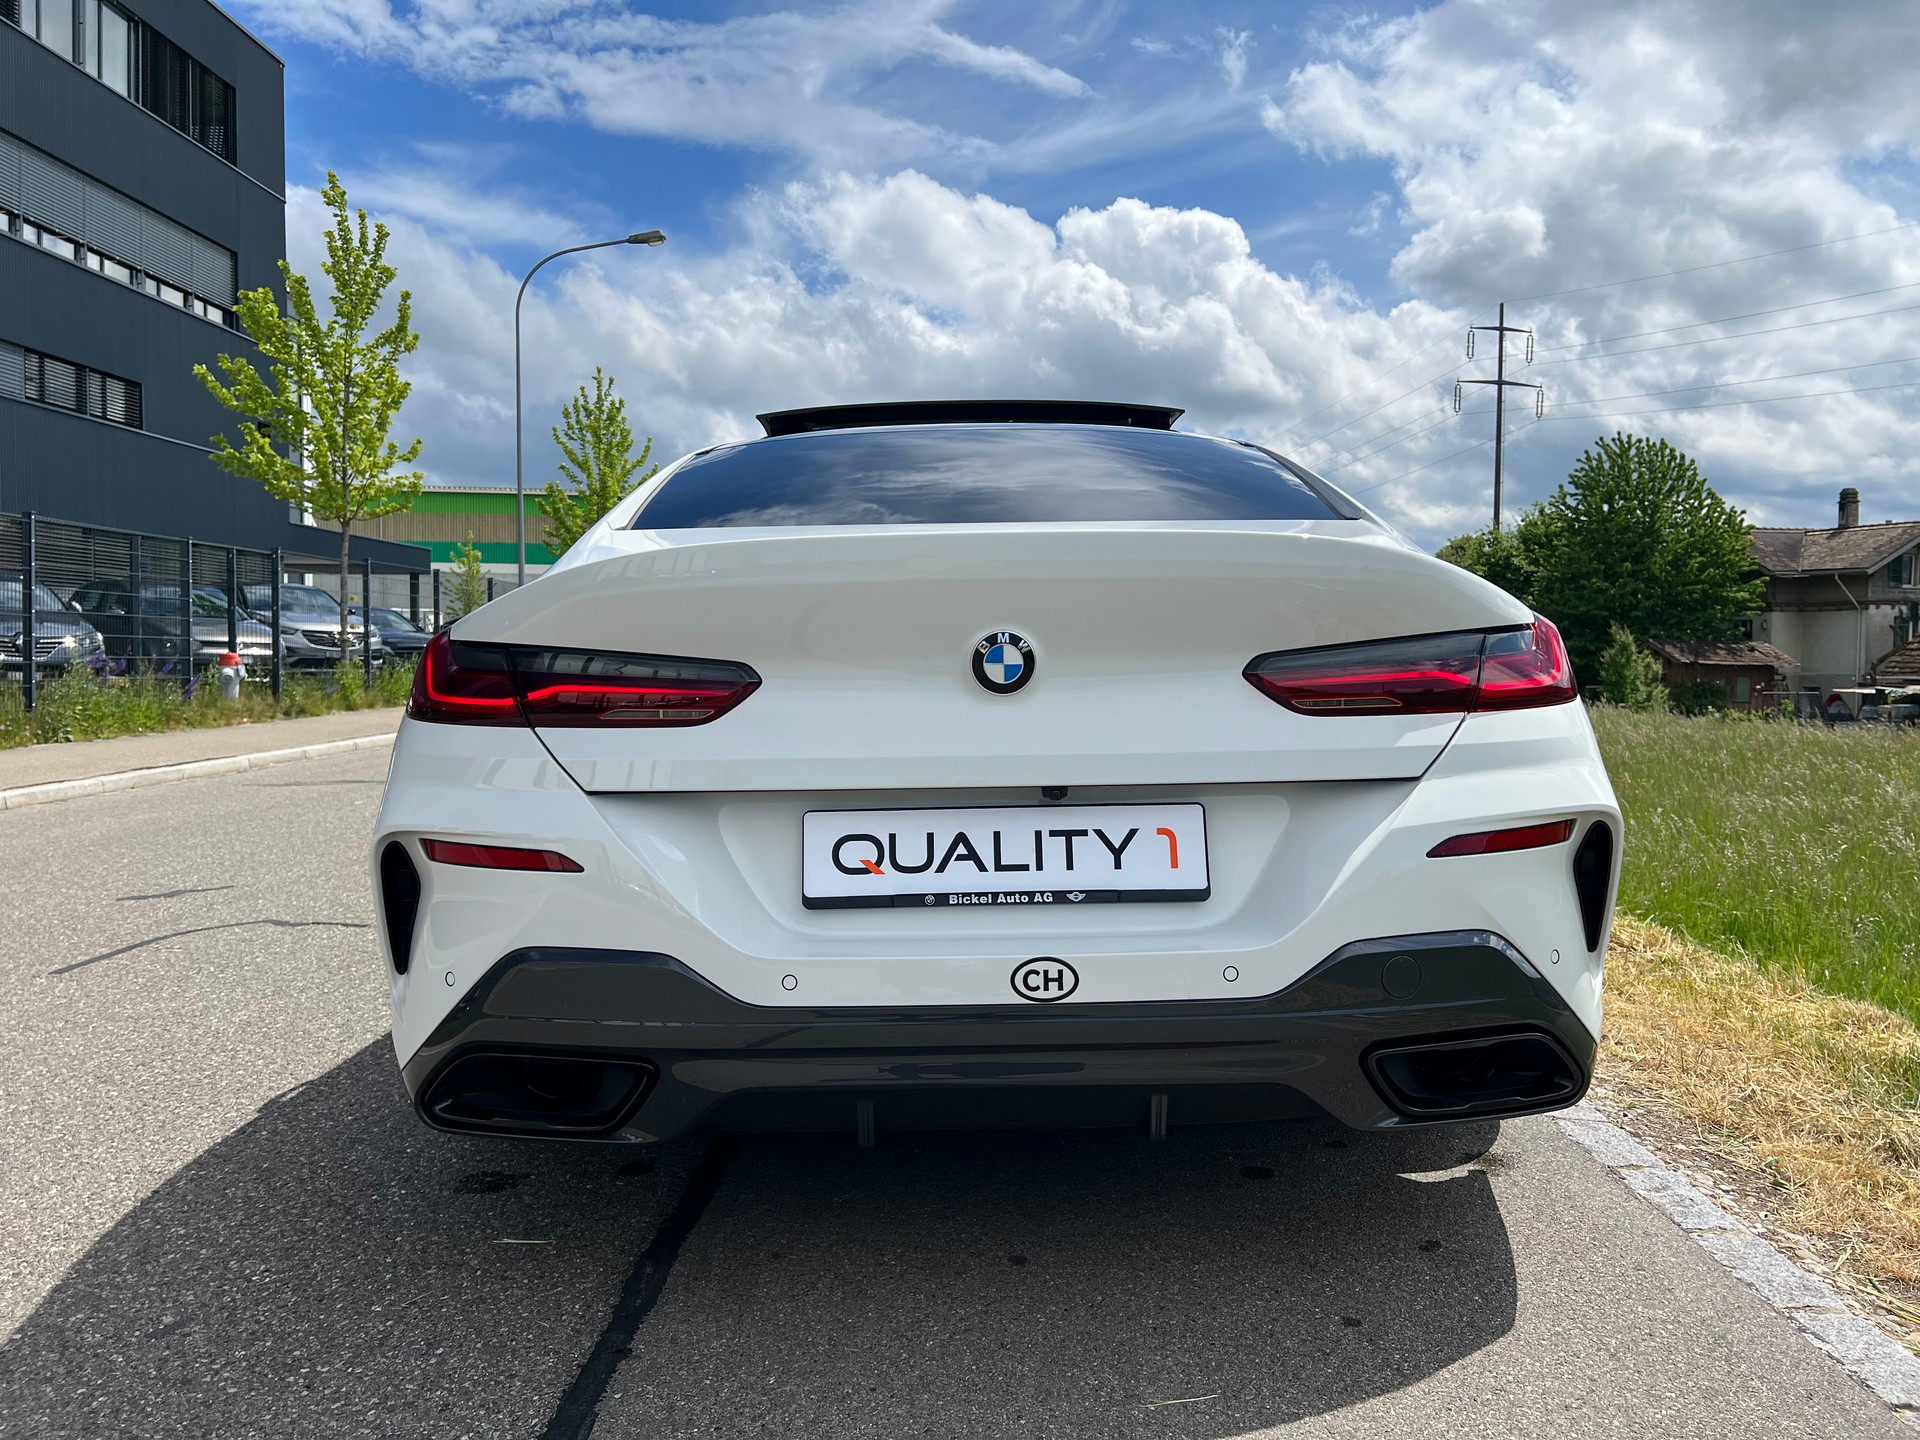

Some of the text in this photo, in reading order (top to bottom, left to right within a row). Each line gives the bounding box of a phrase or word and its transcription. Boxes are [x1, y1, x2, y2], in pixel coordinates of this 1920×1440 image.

[977, 633, 1030, 654] BMW
[831, 828, 1140, 875] QUALITY
[949, 892, 1053, 904] Bickel Auto AG
[1022, 968, 1064, 992] CH
